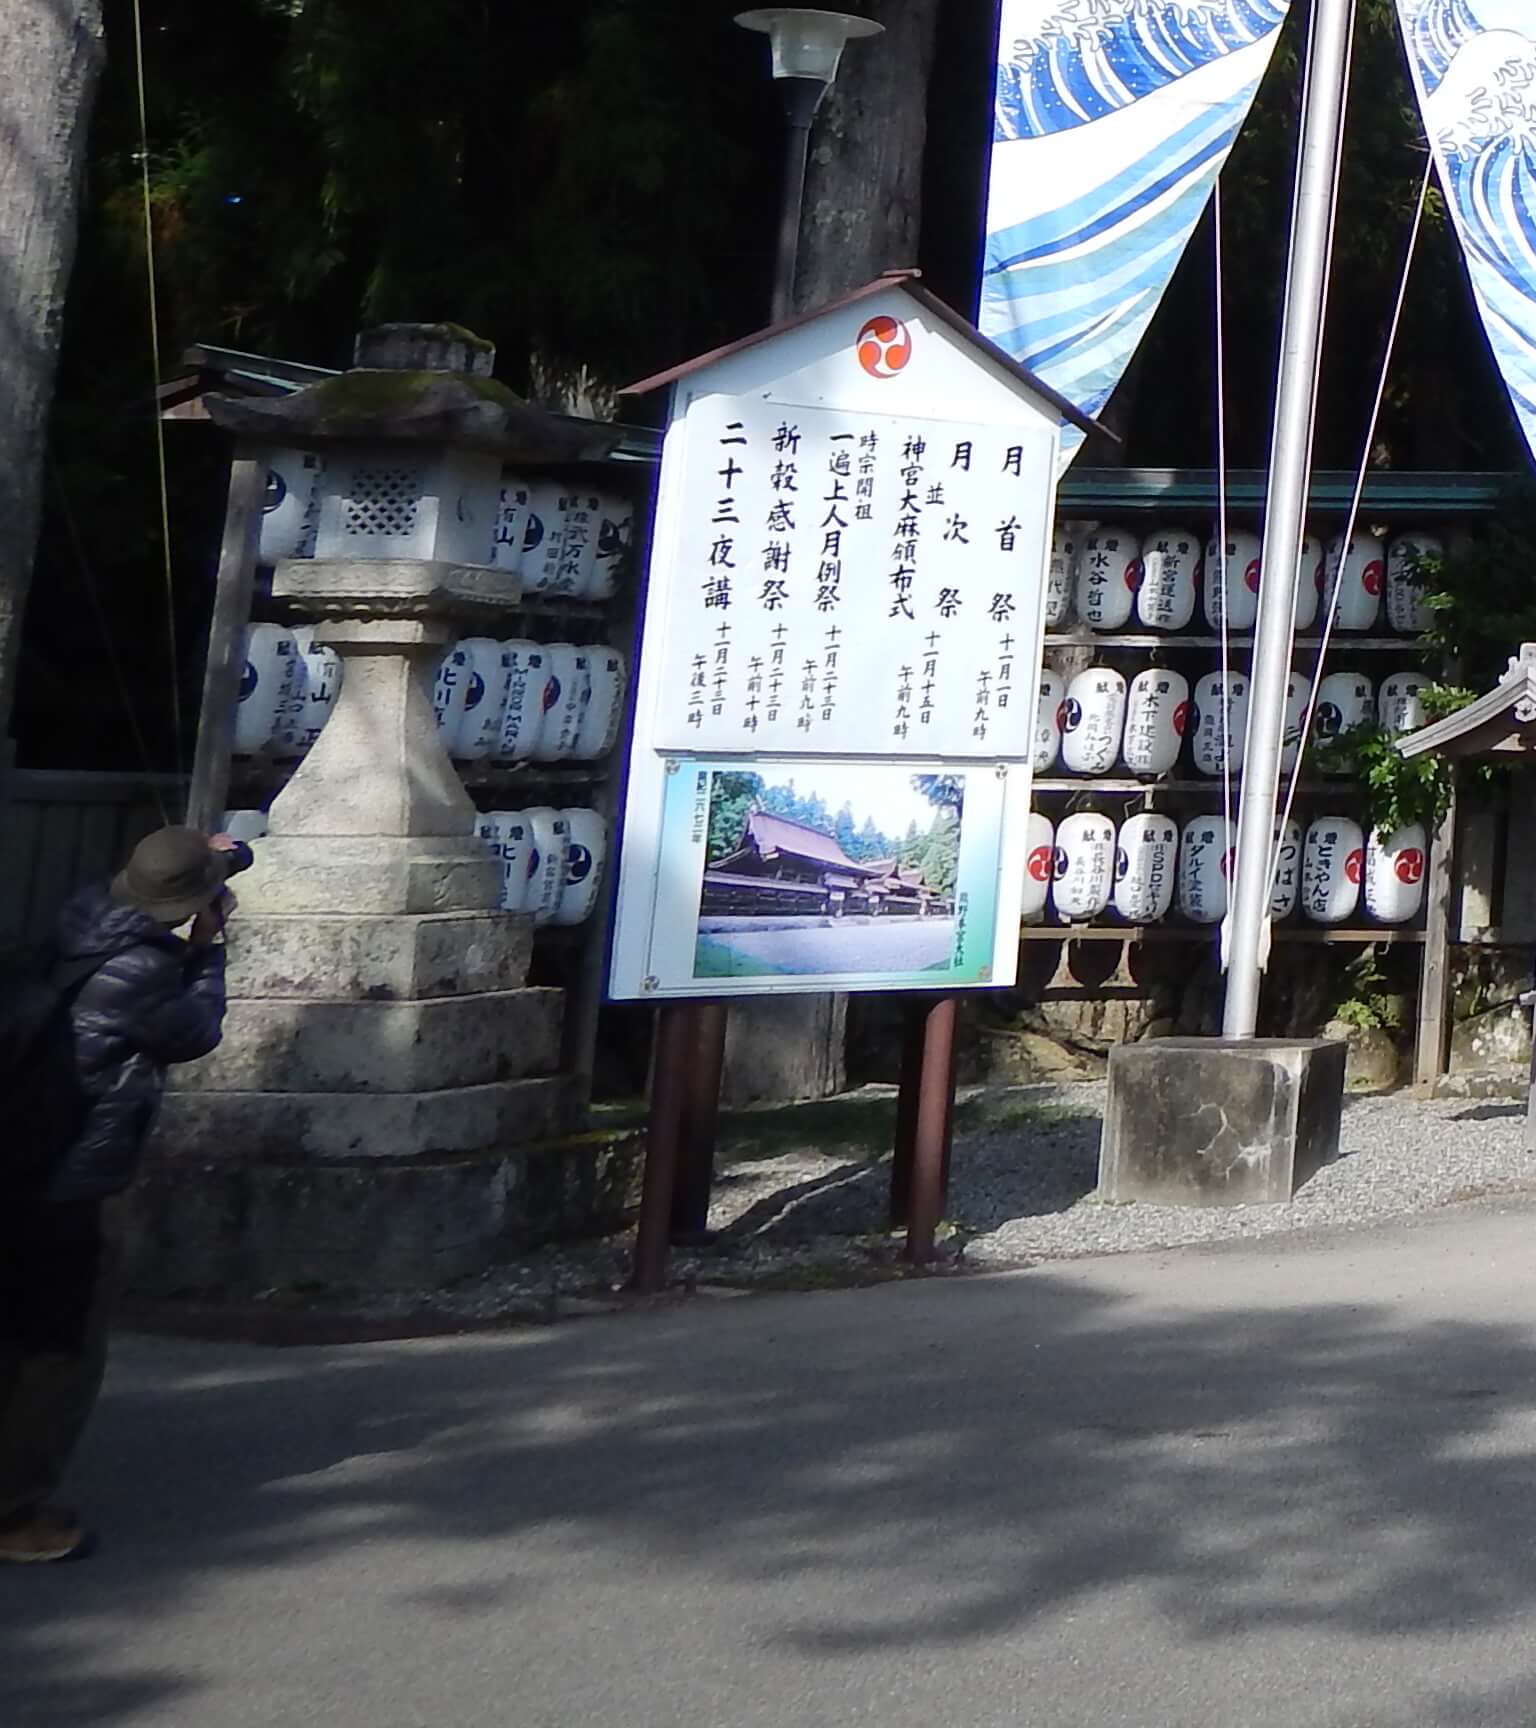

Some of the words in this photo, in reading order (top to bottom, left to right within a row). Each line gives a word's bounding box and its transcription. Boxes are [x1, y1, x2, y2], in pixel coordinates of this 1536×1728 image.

[700, 422, 748, 611] 二十三夜講
[758, 420, 802, 612] 新穀感謝祭
[854, 429, 880, 521] 時宗開祖
[925, 480, 945, 506] 並
[814, 433, 855, 613] 一遍上人月例祭
[888, 434, 926, 620] 神宮大麻頒布式
[935, 440, 974, 619] 月次祭
[986, 445, 1024, 623] 月首祭
[1087, 552, 1111, 623] 水谷哲也
[686, 653, 708, 729] 午後三時
[710, 621, 732, 716] 十一月二十三日
[743, 655, 764, 734] 午前十時
[765, 622, 789, 722] 十一月二十三日
[797, 658, 819, 734] 午前九時
[820, 624, 843, 722] 十一月二十三日
[892, 664, 915, 741] 午前九時
[919, 630, 942, 725] 十一月十五日
[972, 669, 993, 741] 午前九時
[995, 633, 1015, 709] 十一月一日
